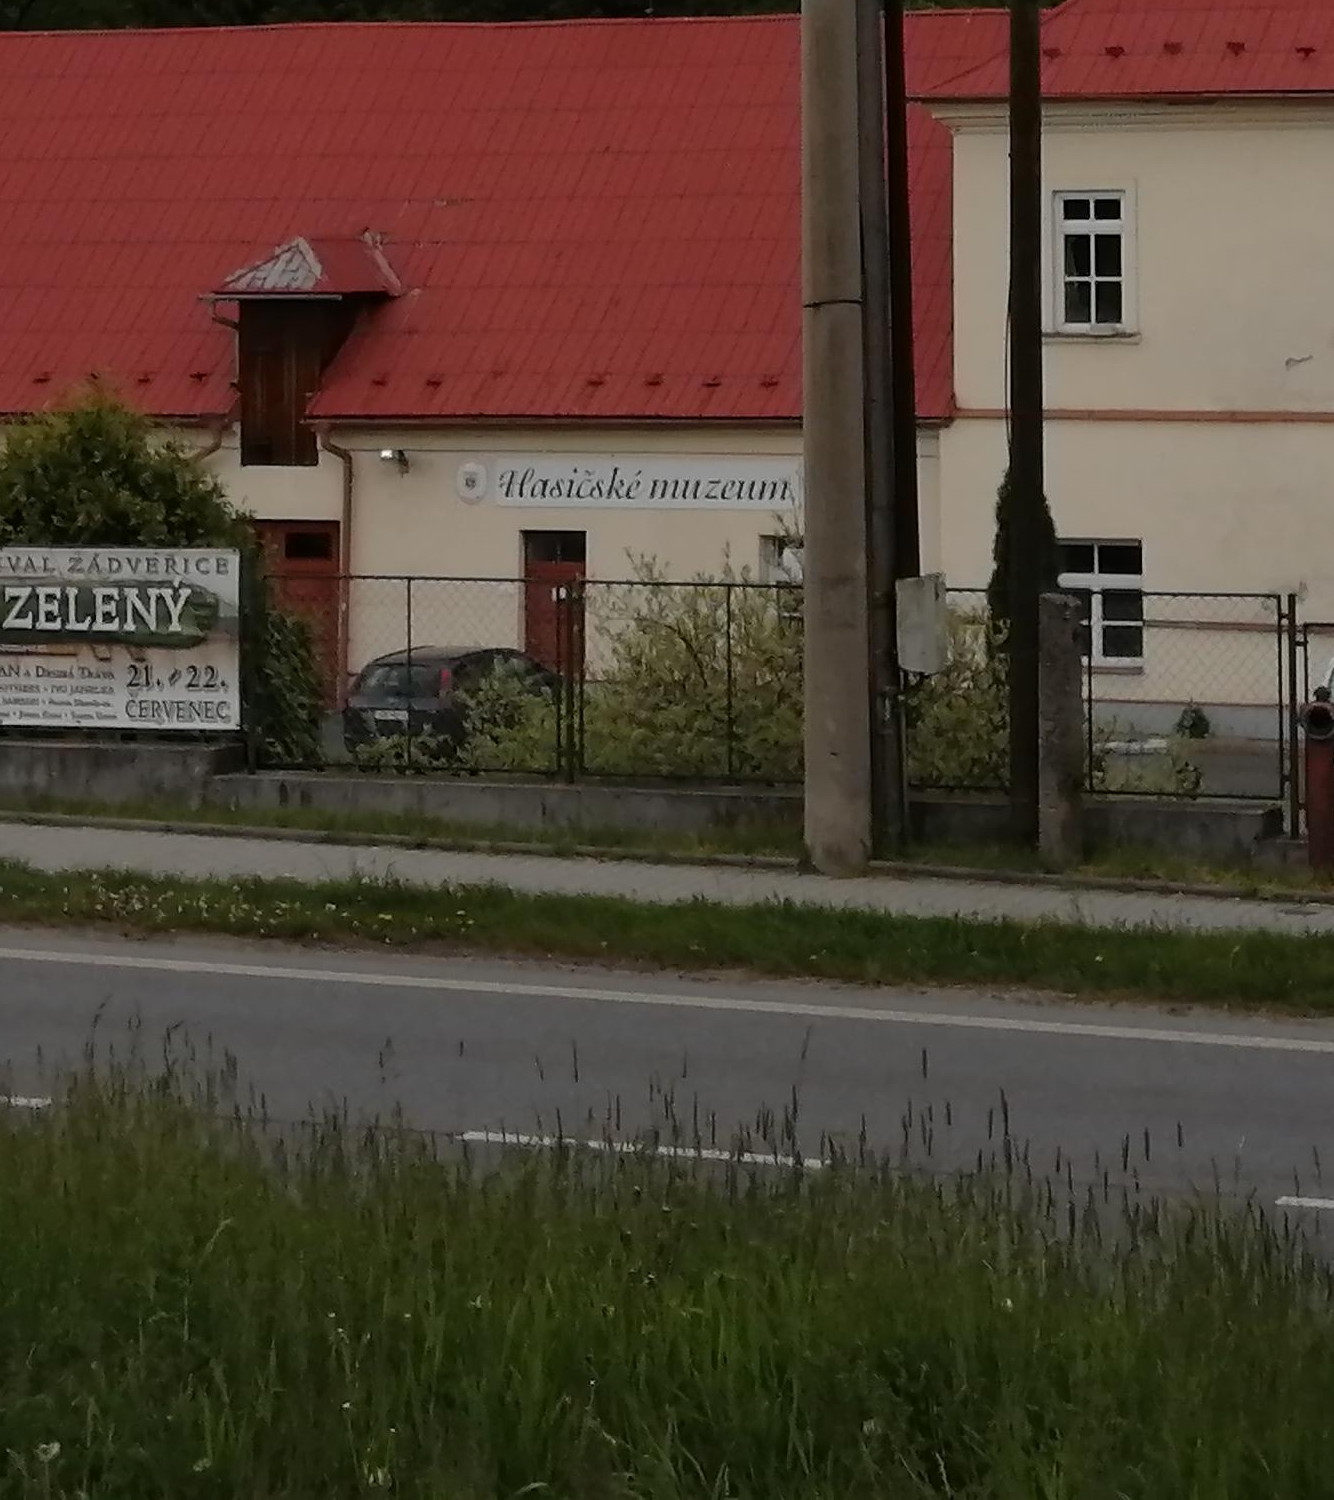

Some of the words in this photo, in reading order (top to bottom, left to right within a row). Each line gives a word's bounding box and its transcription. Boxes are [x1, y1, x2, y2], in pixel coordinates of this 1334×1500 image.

[498, 466, 643, 500] Hlasičské
[648, 478, 789, 501] muzeum
[2, 575, 192, 632] ZELENÝ
[126, 664, 162, 689] 21.
[185, 664, 228, 690] 22.
